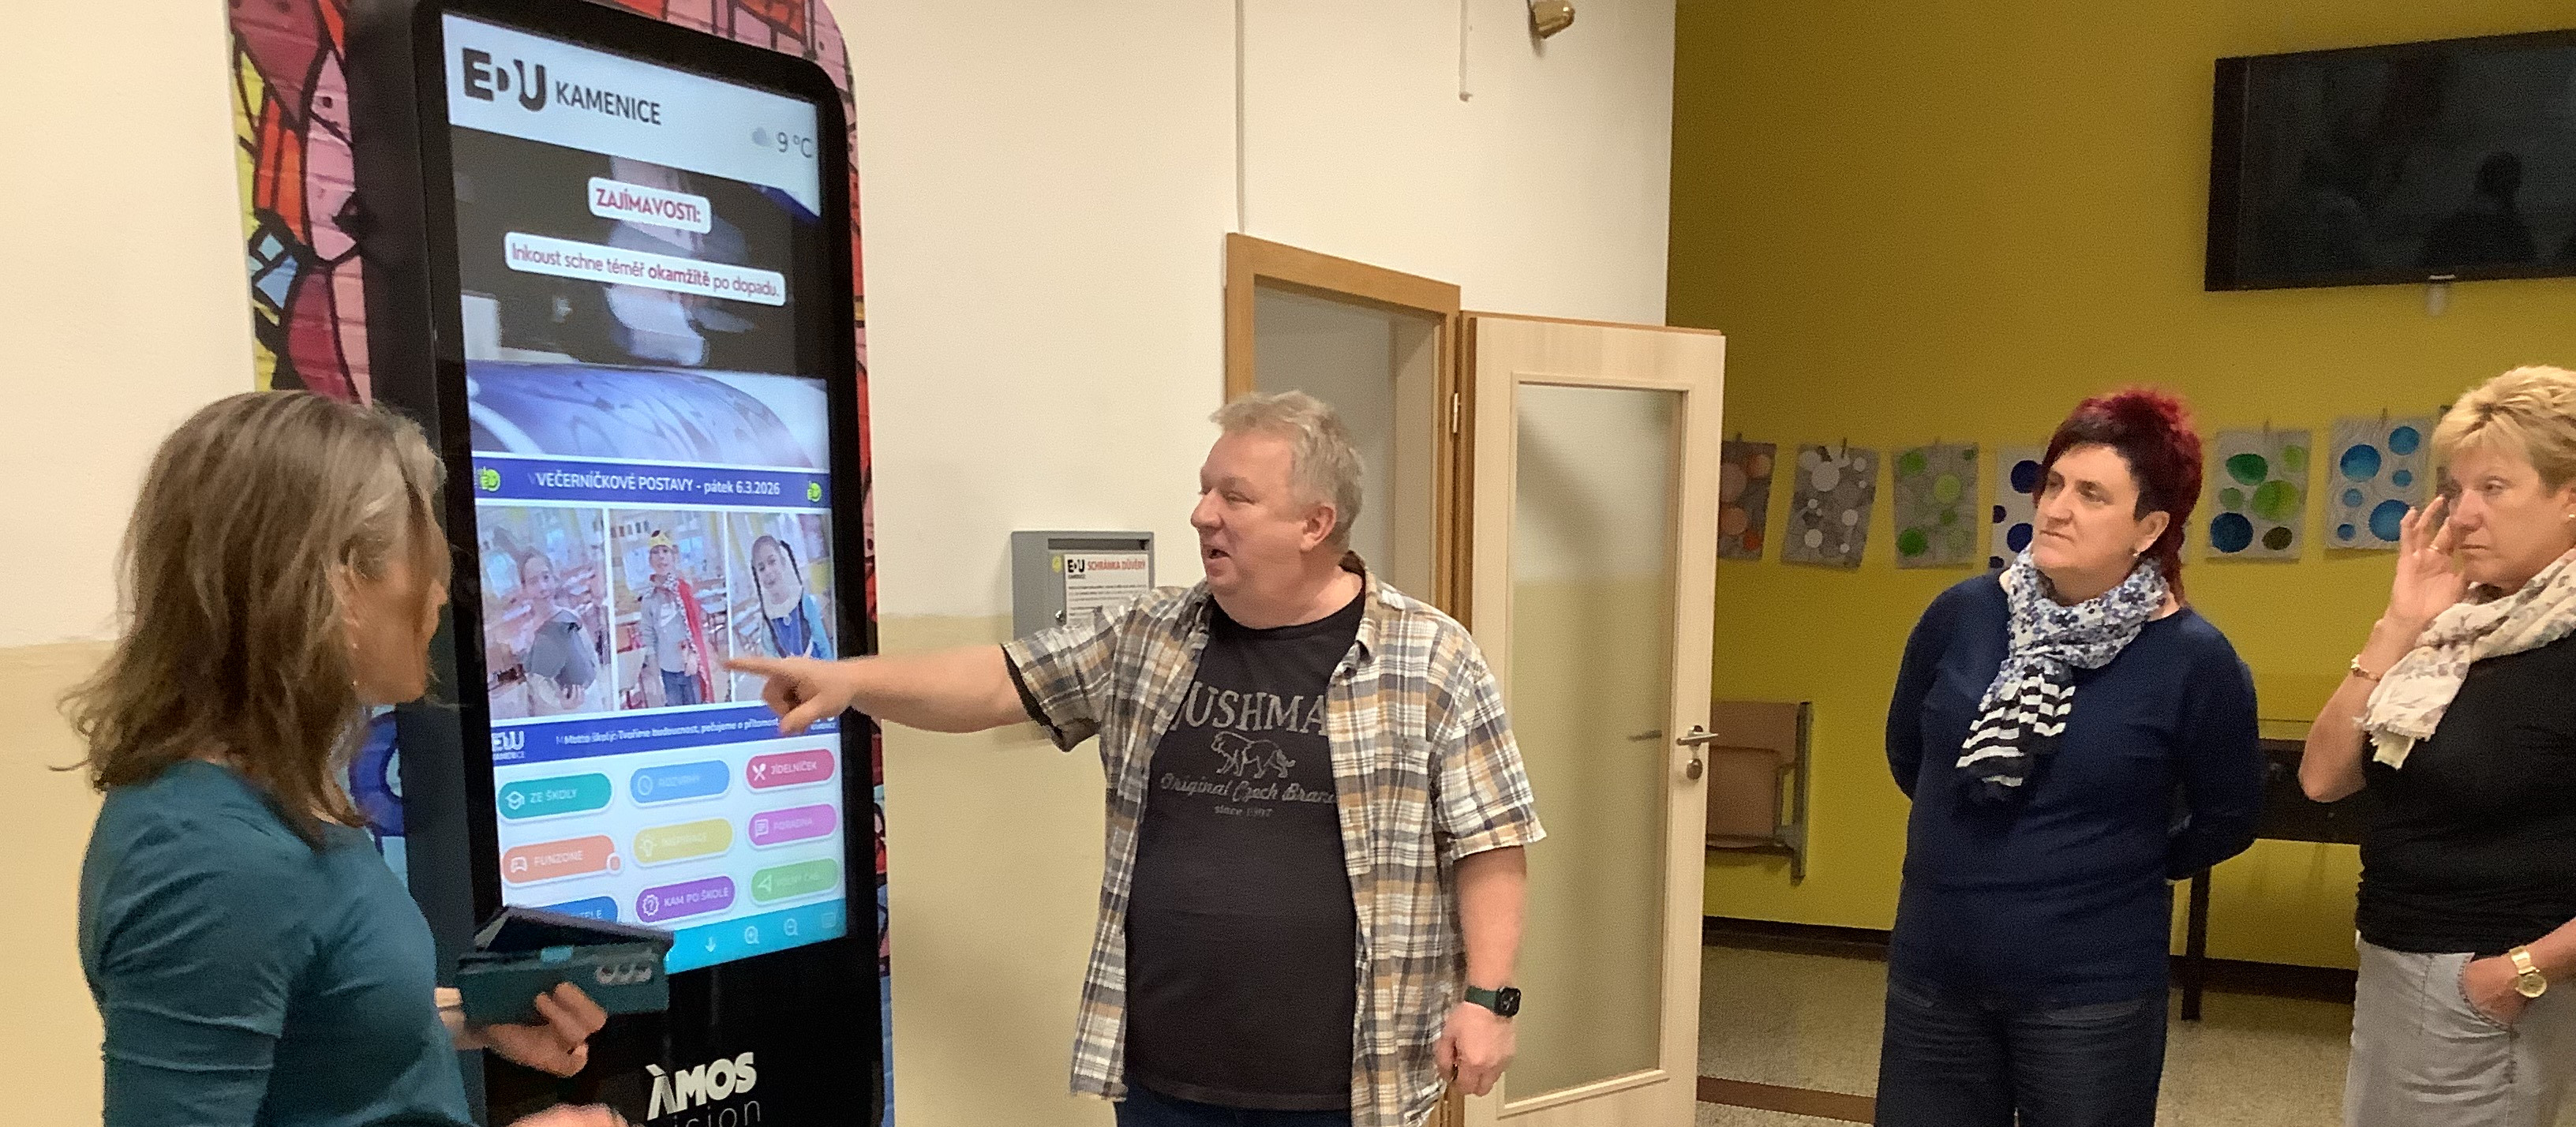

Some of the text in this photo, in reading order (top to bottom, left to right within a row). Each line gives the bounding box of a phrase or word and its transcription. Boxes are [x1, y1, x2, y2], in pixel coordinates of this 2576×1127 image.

[556, 81, 662, 125] KAMENICE
[777, 133, 813, 159] 9 °C
[596, 188, 701, 223] ZAJÍMAVOSTI:
[513, 242, 780, 298] Inkoust schne téměř okamžitě po dopadu.
[535, 469, 636, 490] VEČERNÍČKOVÉ
[638, 476, 693, 491] POSTAVY
[704, 479, 734, 495] pátek
[736, 481, 781, 495] 6.3.2026
[1170, 681, 1328, 736] USHMA
[530, 792, 543, 803] ZE
[1160, 773, 1233, 797] Original
[1233, 781, 1279, 803] Czech
[664, 895, 684, 907] KAM
[686, 893, 700, 903] PO
